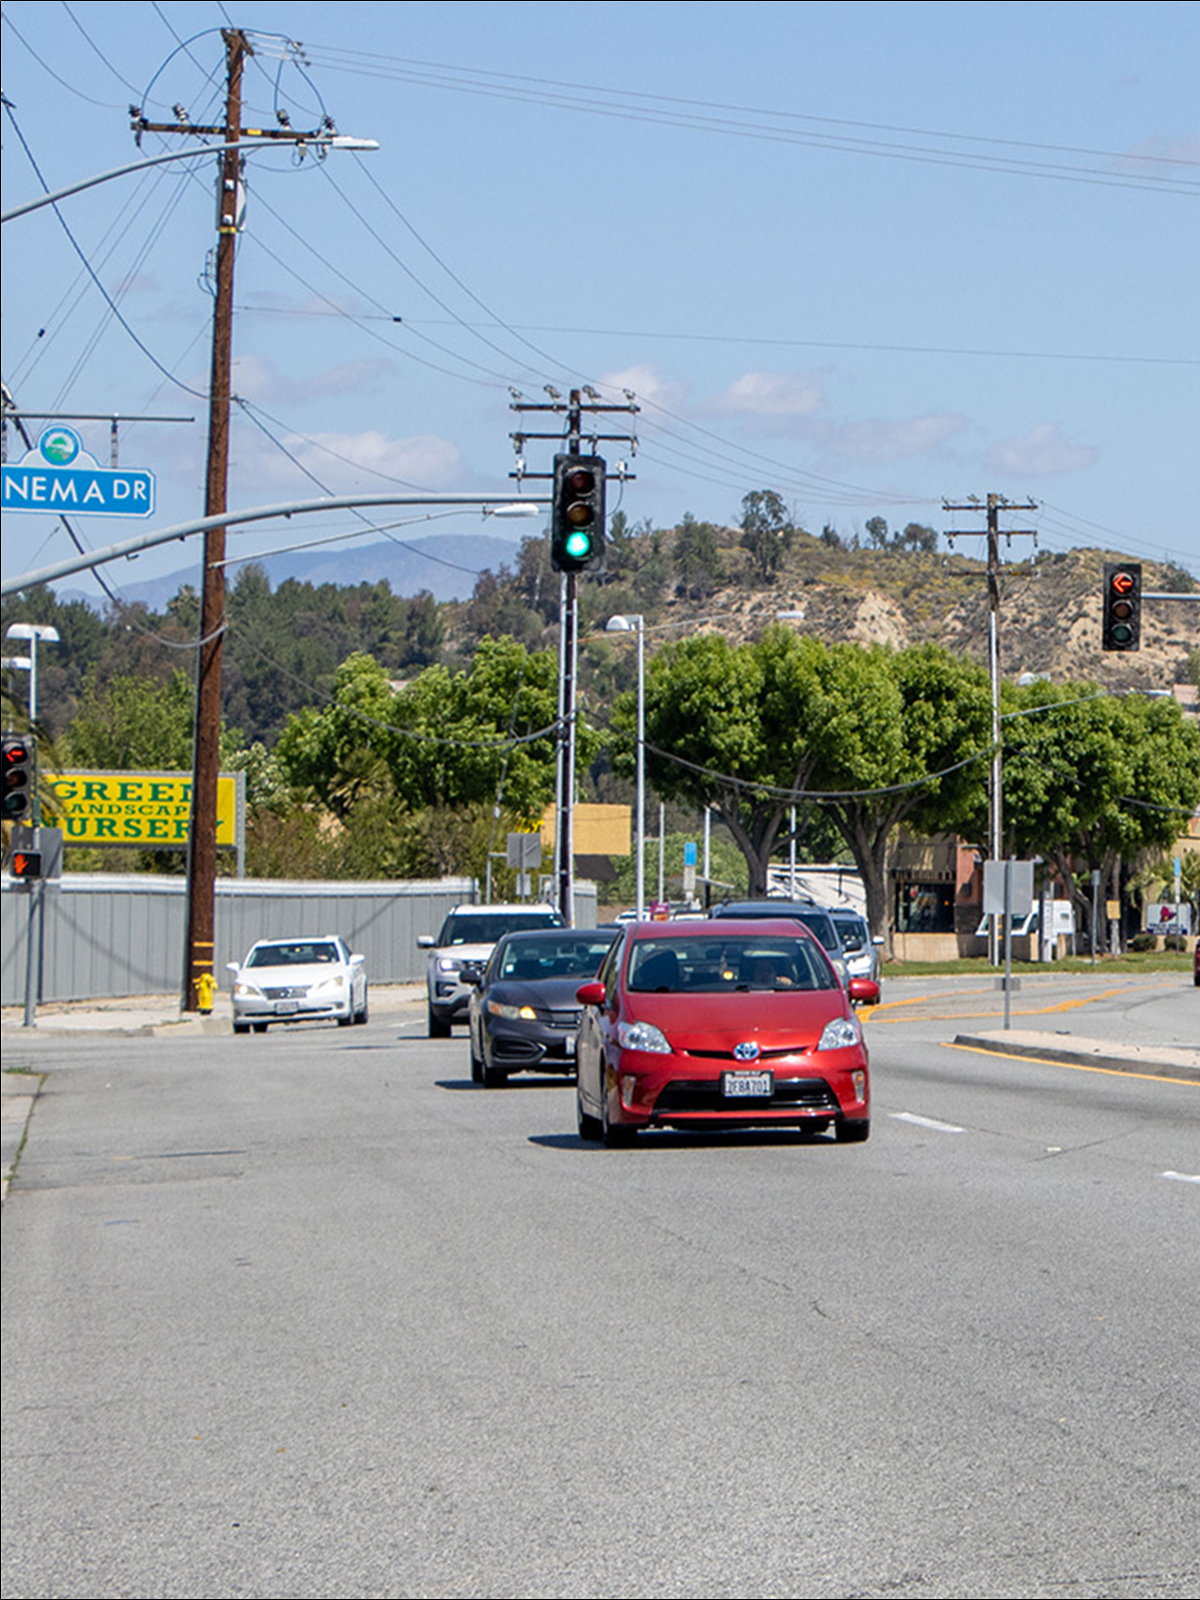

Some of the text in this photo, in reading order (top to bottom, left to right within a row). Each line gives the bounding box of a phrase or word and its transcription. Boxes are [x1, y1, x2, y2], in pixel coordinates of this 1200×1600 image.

[5, 475, 147, 504] NEMA DR
[70, 803, 188, 816] ANDSCAP
[41, 816, 224, 839] URSER
